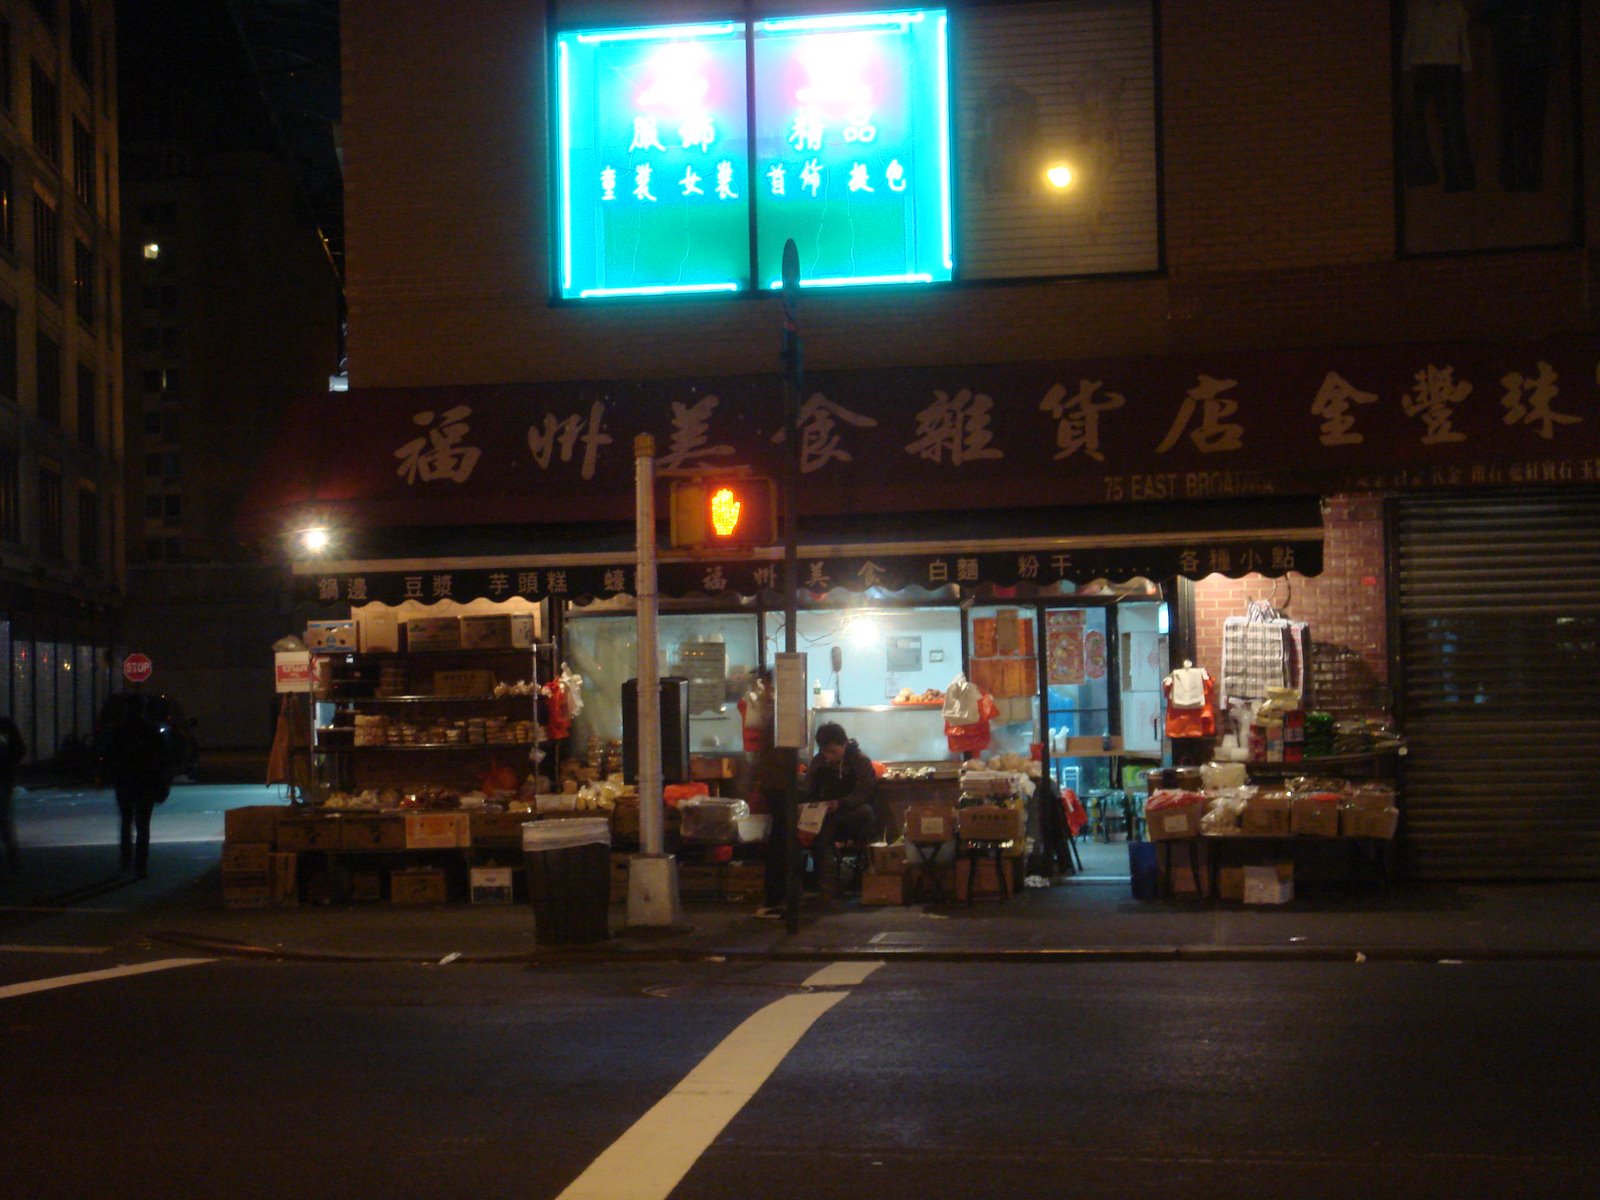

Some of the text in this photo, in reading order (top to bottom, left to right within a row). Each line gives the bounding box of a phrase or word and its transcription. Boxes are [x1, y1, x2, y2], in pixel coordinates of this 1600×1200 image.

[1311, 360, 1600, 446] 金豐珠
[1104, 469, 1278, 501] 75 EAST BROA
[488, 570, 568, 595] 芋頭糕
[126, 662, 149, 673] STOP
